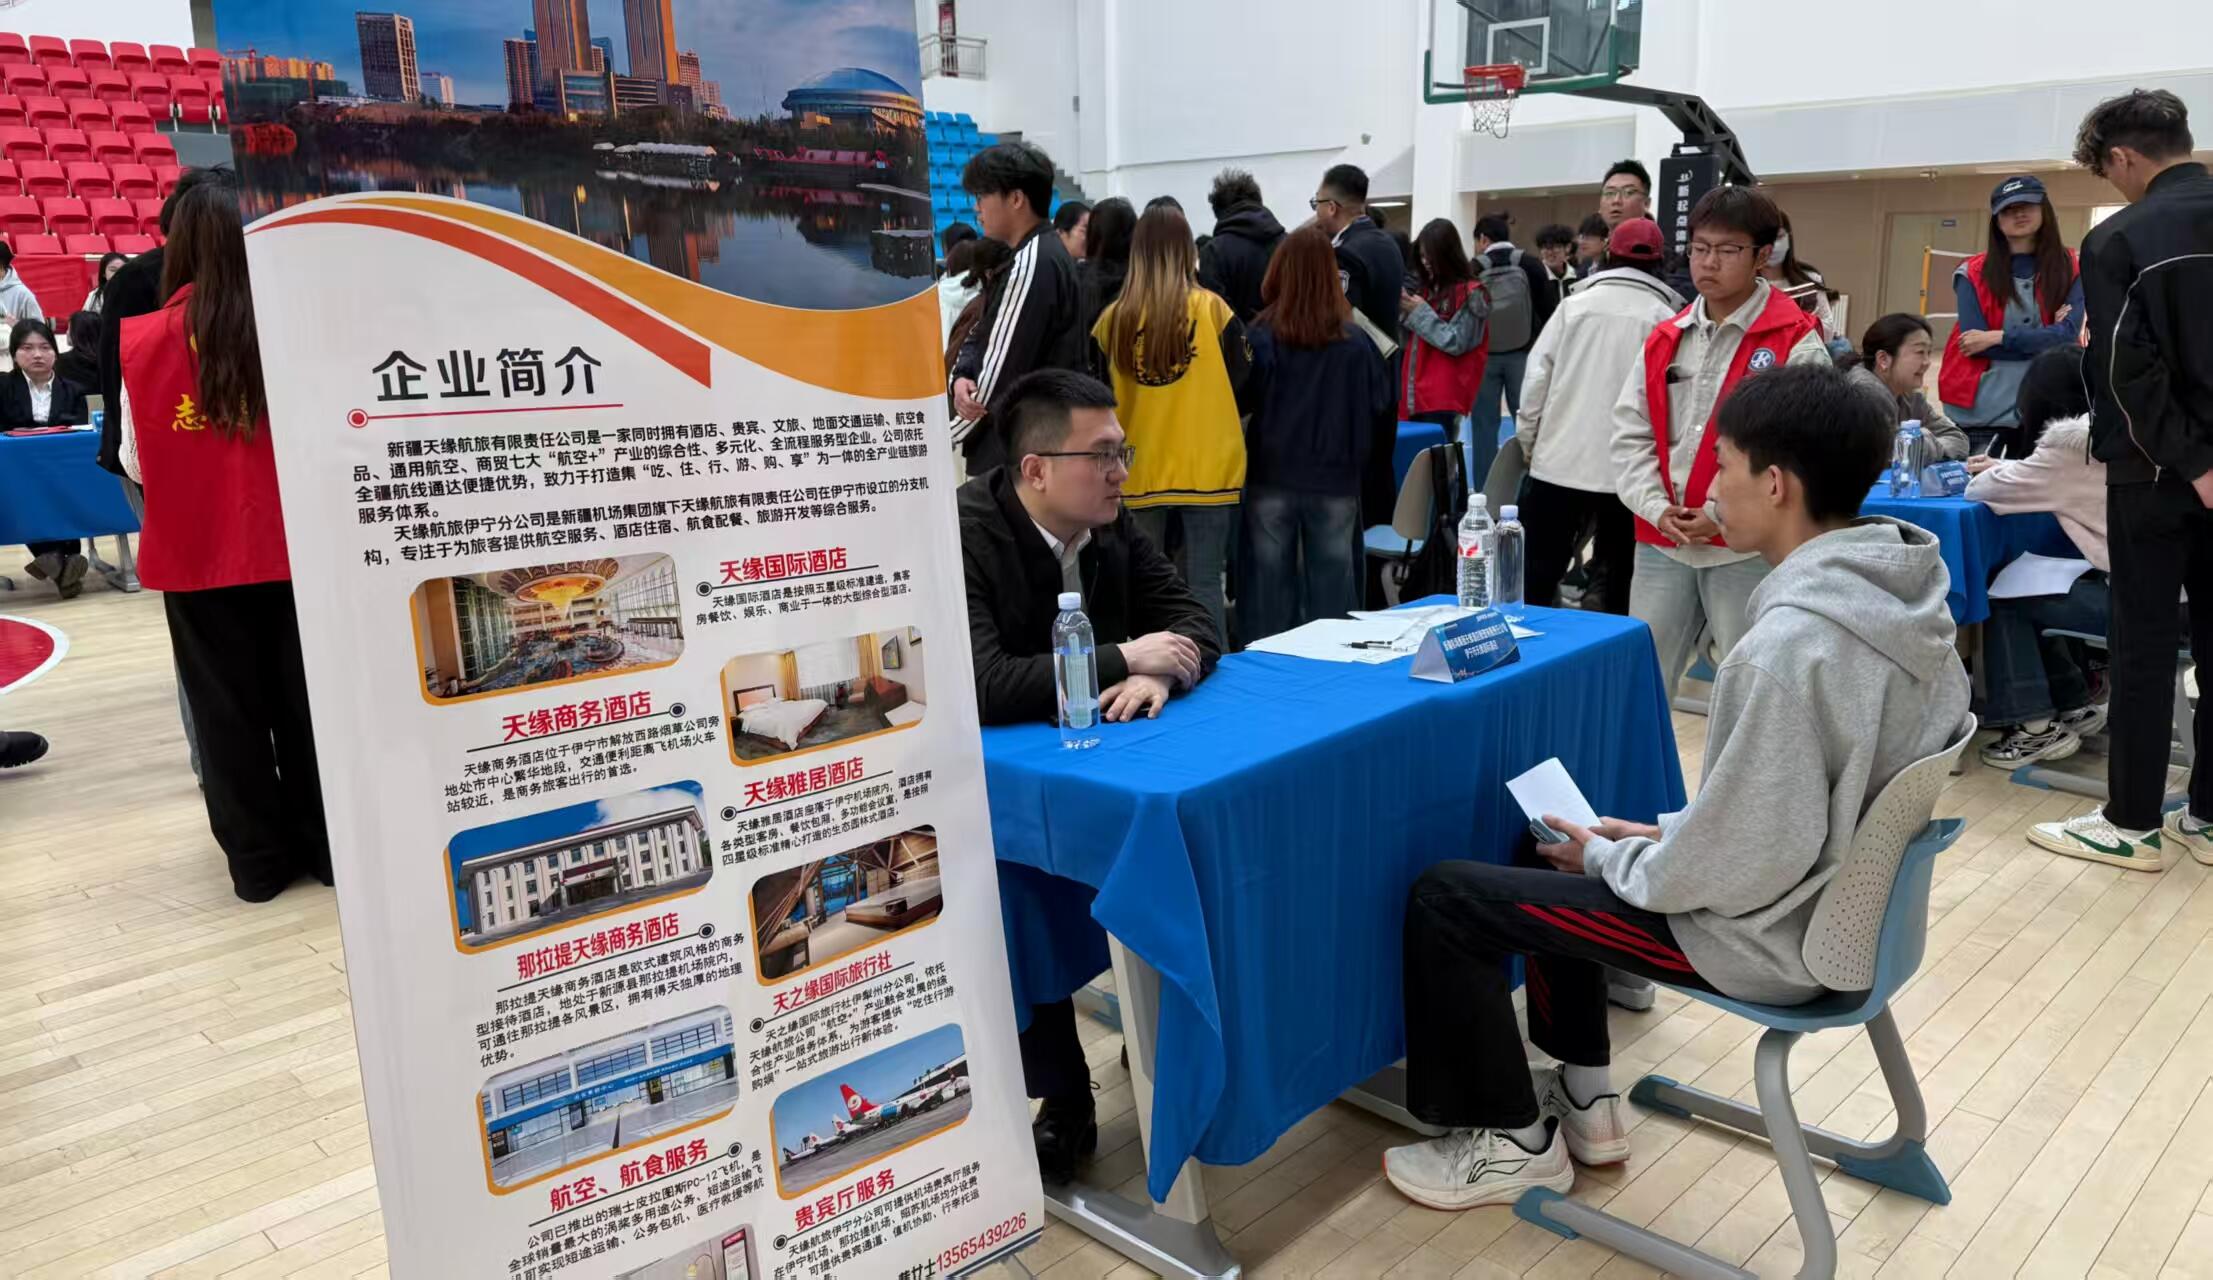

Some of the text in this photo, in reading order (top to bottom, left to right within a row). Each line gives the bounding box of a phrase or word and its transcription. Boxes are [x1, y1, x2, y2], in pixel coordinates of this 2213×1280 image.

[372, 346, 602, 402] 企业简介
[387, 411, 925, 458] 新疆天缘航旅有限责任公司是一家同时拥有酒店、贵宾、文旅、地面交通运输、航空食
[358, 502, 441, 525] 服务体系。
[394, 477, 929, 542] 天缘航旅伊宁分公司是新疆机场集团旗下天缘航旅有限责任公司在伊宁市设立的分支机
[719, 547, 847, 585] 天缘国际酒店
[464, 715, 720, 777] 天缘商务酒店位于伊宁市解放西路烟草公司旁
[502, 691, 651, 742] 天缘商务酒店
[444, 733, 716, 797] 地处市中心繁华地段，交通便利距离飞机场火车
[446, 765, 637, 813] 站较近，是商务旅客出行的首选。
[744, 757, 864, 806] 天缘雅居酒店
[495, 933, 744, 1015] 那拉提天缘商务酒店是欧式建筑风格的商务
[517, 912, 679, 980] 那拉提天缘商务酒店
[478, 962, 743, 1051] 可通往那拉提各风景区，拥有得天独厚的地理
[773, 950, 893, 1015] 天之缘国际旅行社
[480, 1046, 515, 1068] 优势。
[550, 1139, 709, 1213] 航空、航食服务
[795, 1168, 895, 1231] 贵宾厅服务
[788, 1160, 981, 1258] 天缘航旅伊宁分公司可提供机场贵宾厅服务
